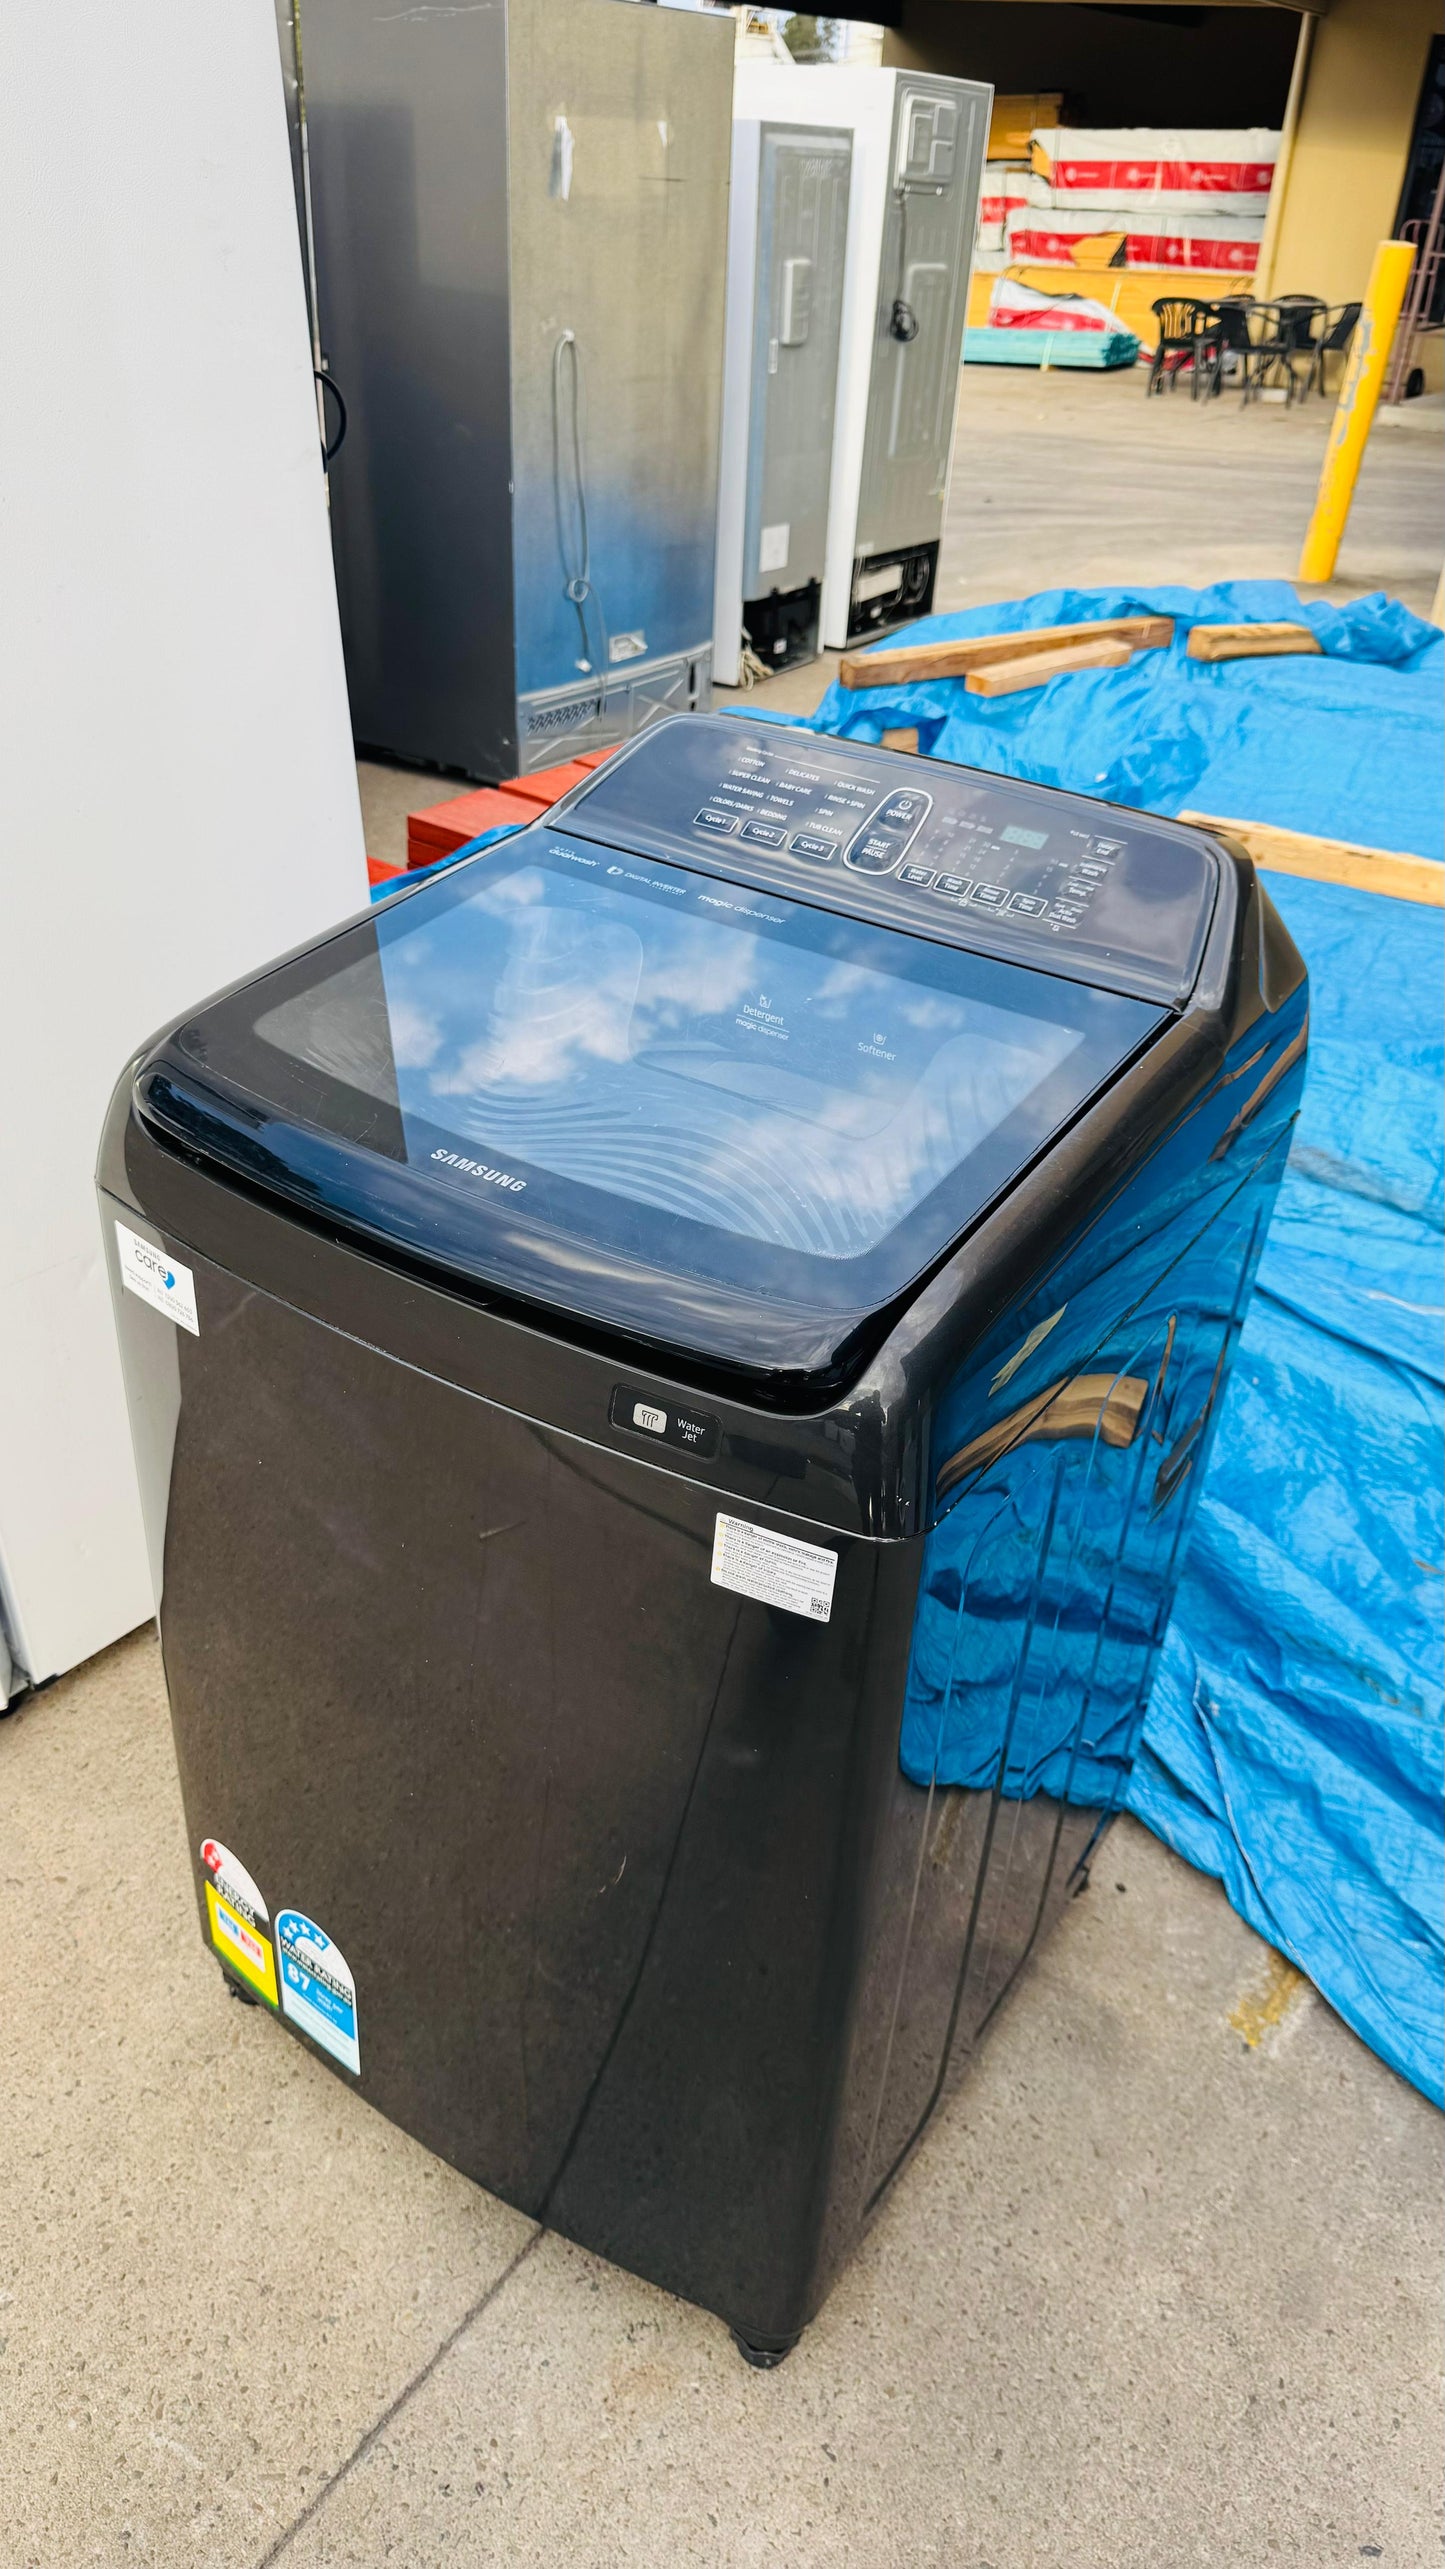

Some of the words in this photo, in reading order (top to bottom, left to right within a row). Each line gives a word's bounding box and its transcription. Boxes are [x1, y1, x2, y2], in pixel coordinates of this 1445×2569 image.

[741, 757, 765, 767] COTTON
[731, 769, 751, 779] SUPER
[751, 774, 771, 784] CLEAN
[788, 769, 820, 781] DELICATES
[722, 783, 742, 792] WATER
[742, 788, 765, 798] SAVING
[779, 781, 796, 791] BABY
[795, 786, 813, 795] CARE
[837, 781, 857, 791] QUICK
[856, 786, 876, 795] WASH
[712, 796, 755, 812] COLORS/DARKS
[770, 795, 795, 807] TOWELS
[827, 794, 847, 804] RINSE
[850, 800, 866, 809] SPIN
[704, 814, 722, 825] Cycle
[760, 809, 788, 821] BEDDING
[818, 808, 834, 817] SPIN
[886, 809, 912, 820] POWER
[752, 827, 769, 837] Cycle
[809, 822, 822, 830] TUB
[822, 825, 843, 836] CLEAN
[801, 840, 819, 851] Cycle
[868, 838, 891, 849] START
[861, 848, 885, 858] PAUSE
[625, 872, 651, 885] DIGITAL
[652, 880, 687, 895] INVERTER
[907, 873, 923, 882] Level
[697, 895, 733, 909] magic
[734, 905, 786, 924] dispenser
[743, 1004, 785, 1026] Detergent
[735, 1018, 758, 1031] magic
[758, 1025, 790, 1041] dispenser
[858, 1042, 897, 1062] Softener
[430, 1148, 528, 1192] SAMSUNG
[135, 1249, 167, 1279] care
[677, 1418, 706, 1436] Water
[682, 1431, 698, 1443] Jet
[728, 1518, 754, 1532] Warning
[281, 1935, 314, 1970] WATER
[313, 1961, 353, 2001] RATING
[288, 1962, 310, 1992] 87
